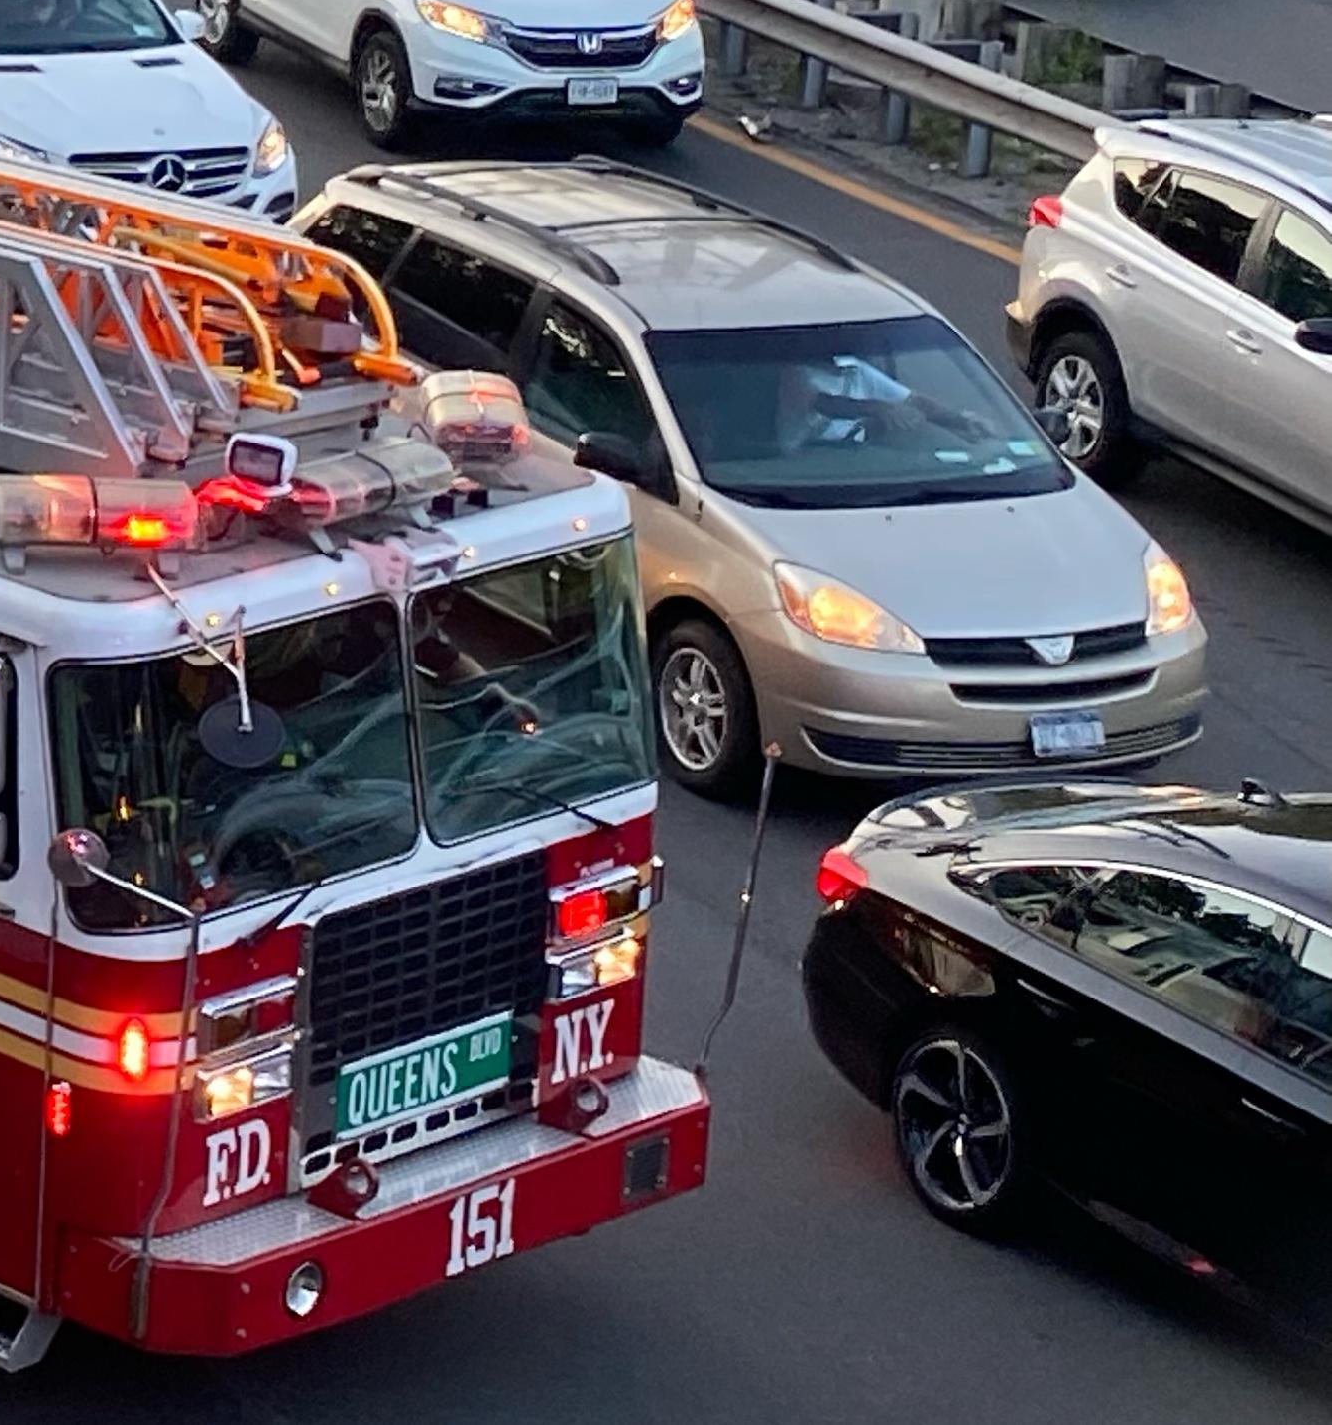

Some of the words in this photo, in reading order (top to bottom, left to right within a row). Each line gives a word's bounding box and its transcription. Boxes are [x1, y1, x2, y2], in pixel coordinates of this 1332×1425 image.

[347, 1041, 459, 1126] QUEENS
[468, 1026, 503, 1062] BLVD
[445, 1178, 517, 1278] 151
